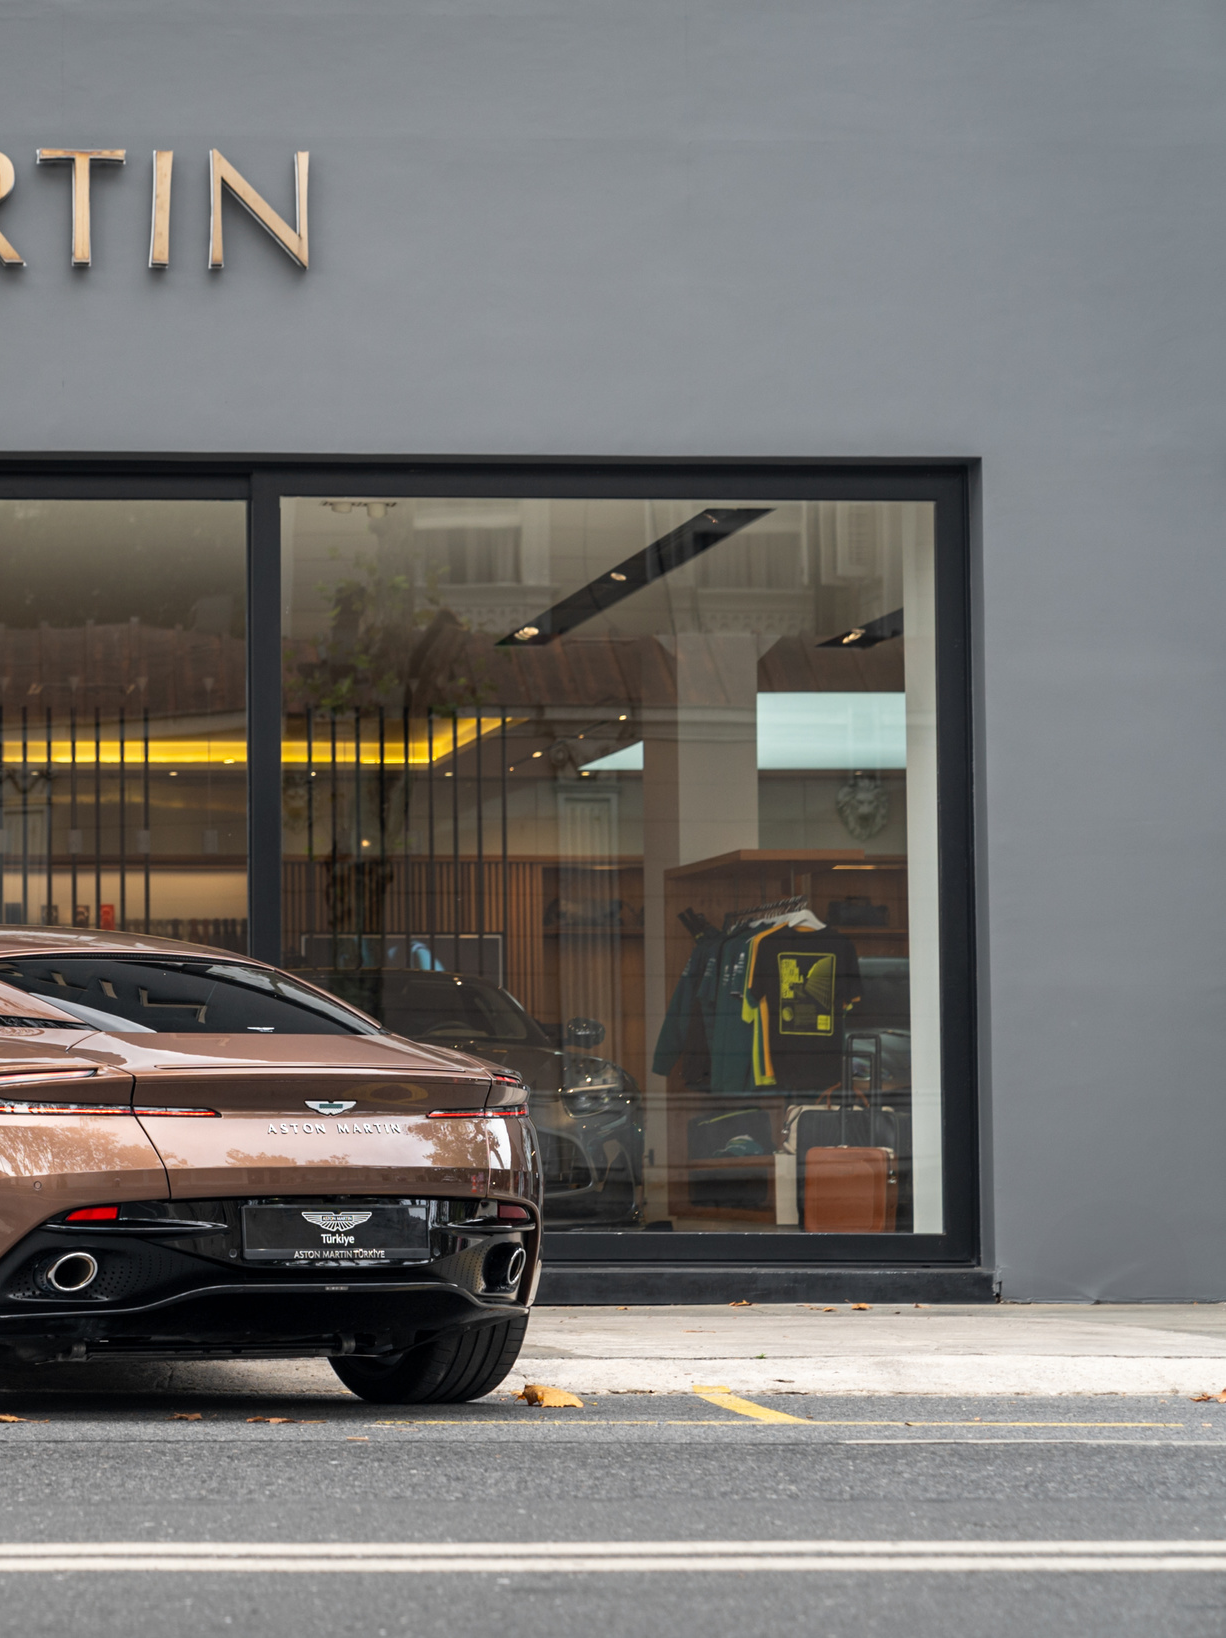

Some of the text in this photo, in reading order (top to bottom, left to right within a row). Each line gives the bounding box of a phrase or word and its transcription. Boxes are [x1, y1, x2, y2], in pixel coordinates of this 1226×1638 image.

[267, 1123, 401, 1135] ASTON MARTIN
[320, 1233, 355, 1247] Türkiye
[294, 1248, 385, 1259] ASTON MARTIN TÜRKİYE
